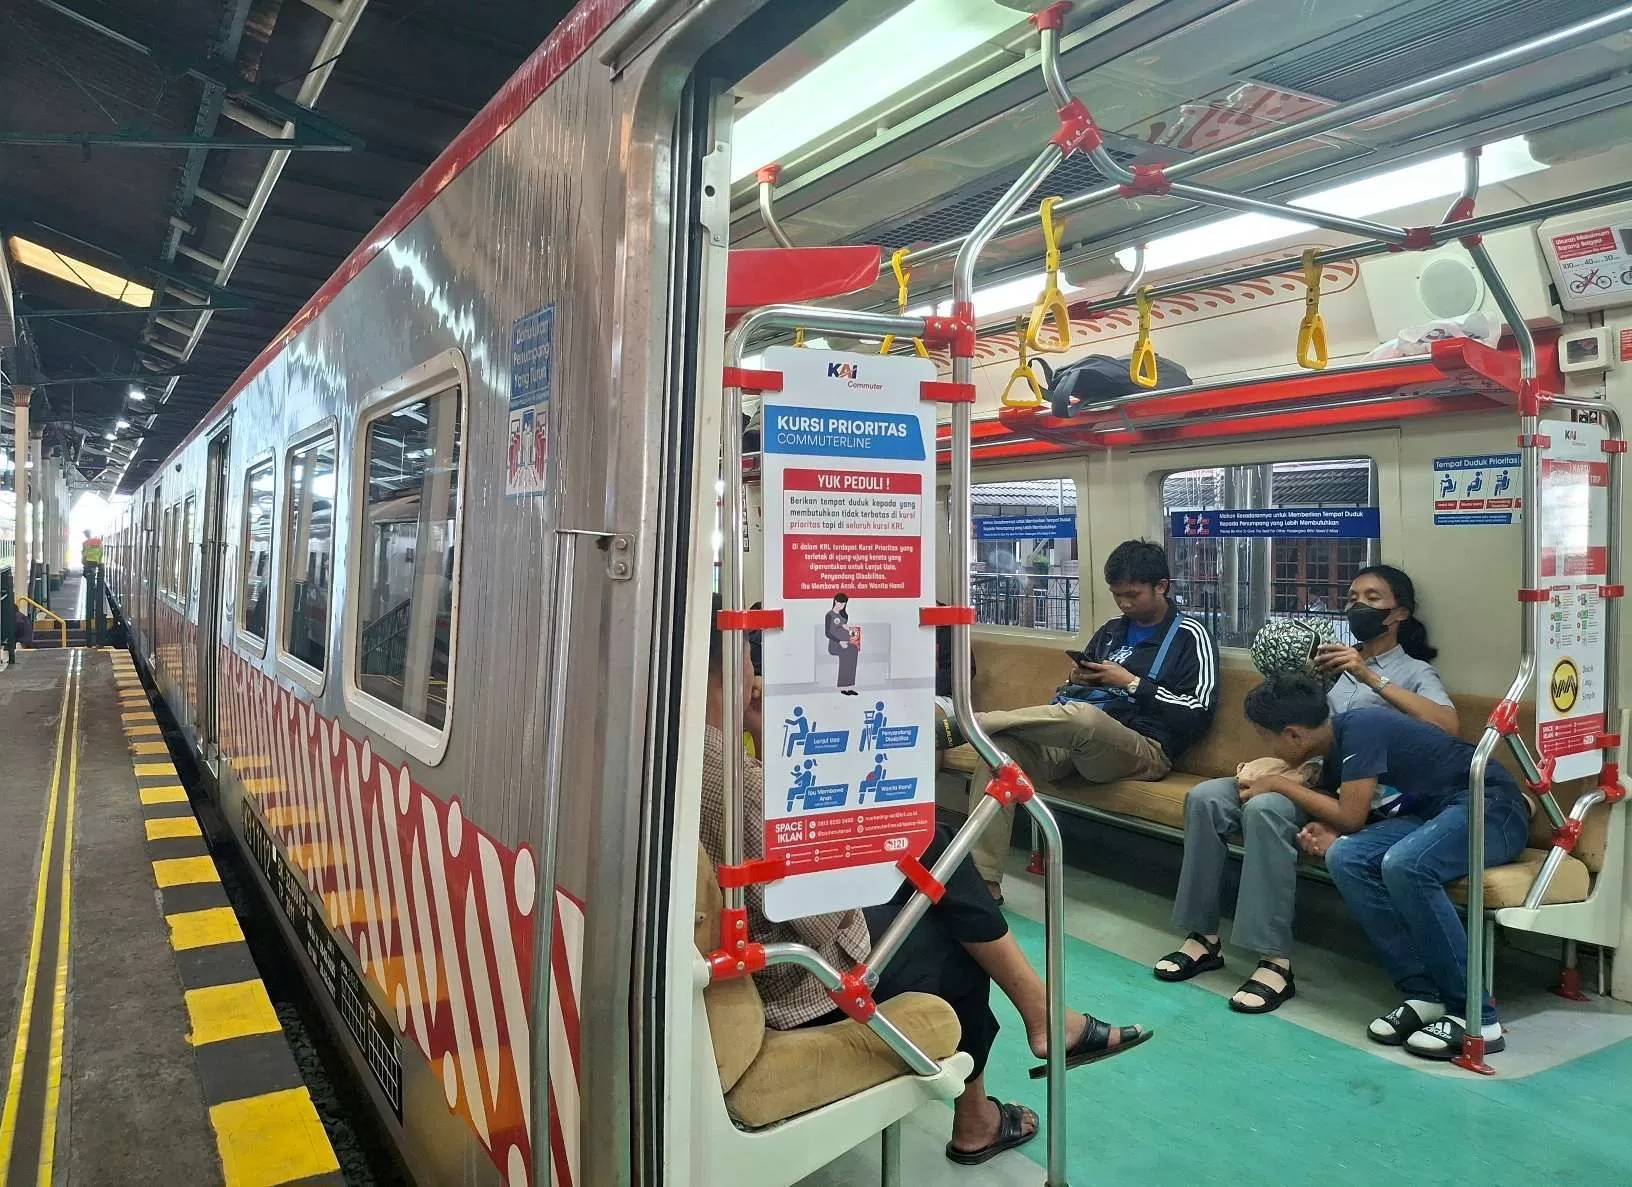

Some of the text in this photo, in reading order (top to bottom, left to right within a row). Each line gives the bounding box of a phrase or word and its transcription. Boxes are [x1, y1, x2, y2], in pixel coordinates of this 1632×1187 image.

[514, 343, 550, 366] Penumpang
[514, 373, 529, 389] Yang
[847, 380, 883, 390] Commuter
[777, 416, 908, 438] KURSI PRIORITAS
[777, 432, 872, 450] COMMUTERLINE
[1436, 460, 1462, 470] Tempat
[1464, 458, 1488, 468] Duduk
[818, 474, 840, 489] YUK
[844, 476, 884, 490] PEDULI
[790, 496, 916, 510] Berikan tempat duduk kepada yang
[790, 510, 840, 518] membutuhkan
[860, 510, 890, 519] terbatas
[790, 520, 821, 530] prioritas
[822, 521, 836, 530] tapi
[838, 522, 844, 530] di
[846, 522, 871, 530] seluruh
[891, 522, 904, 530] KRL
[776, 822, 803, 834] SPACE
[778, 831, 803, 844] IKLAN
